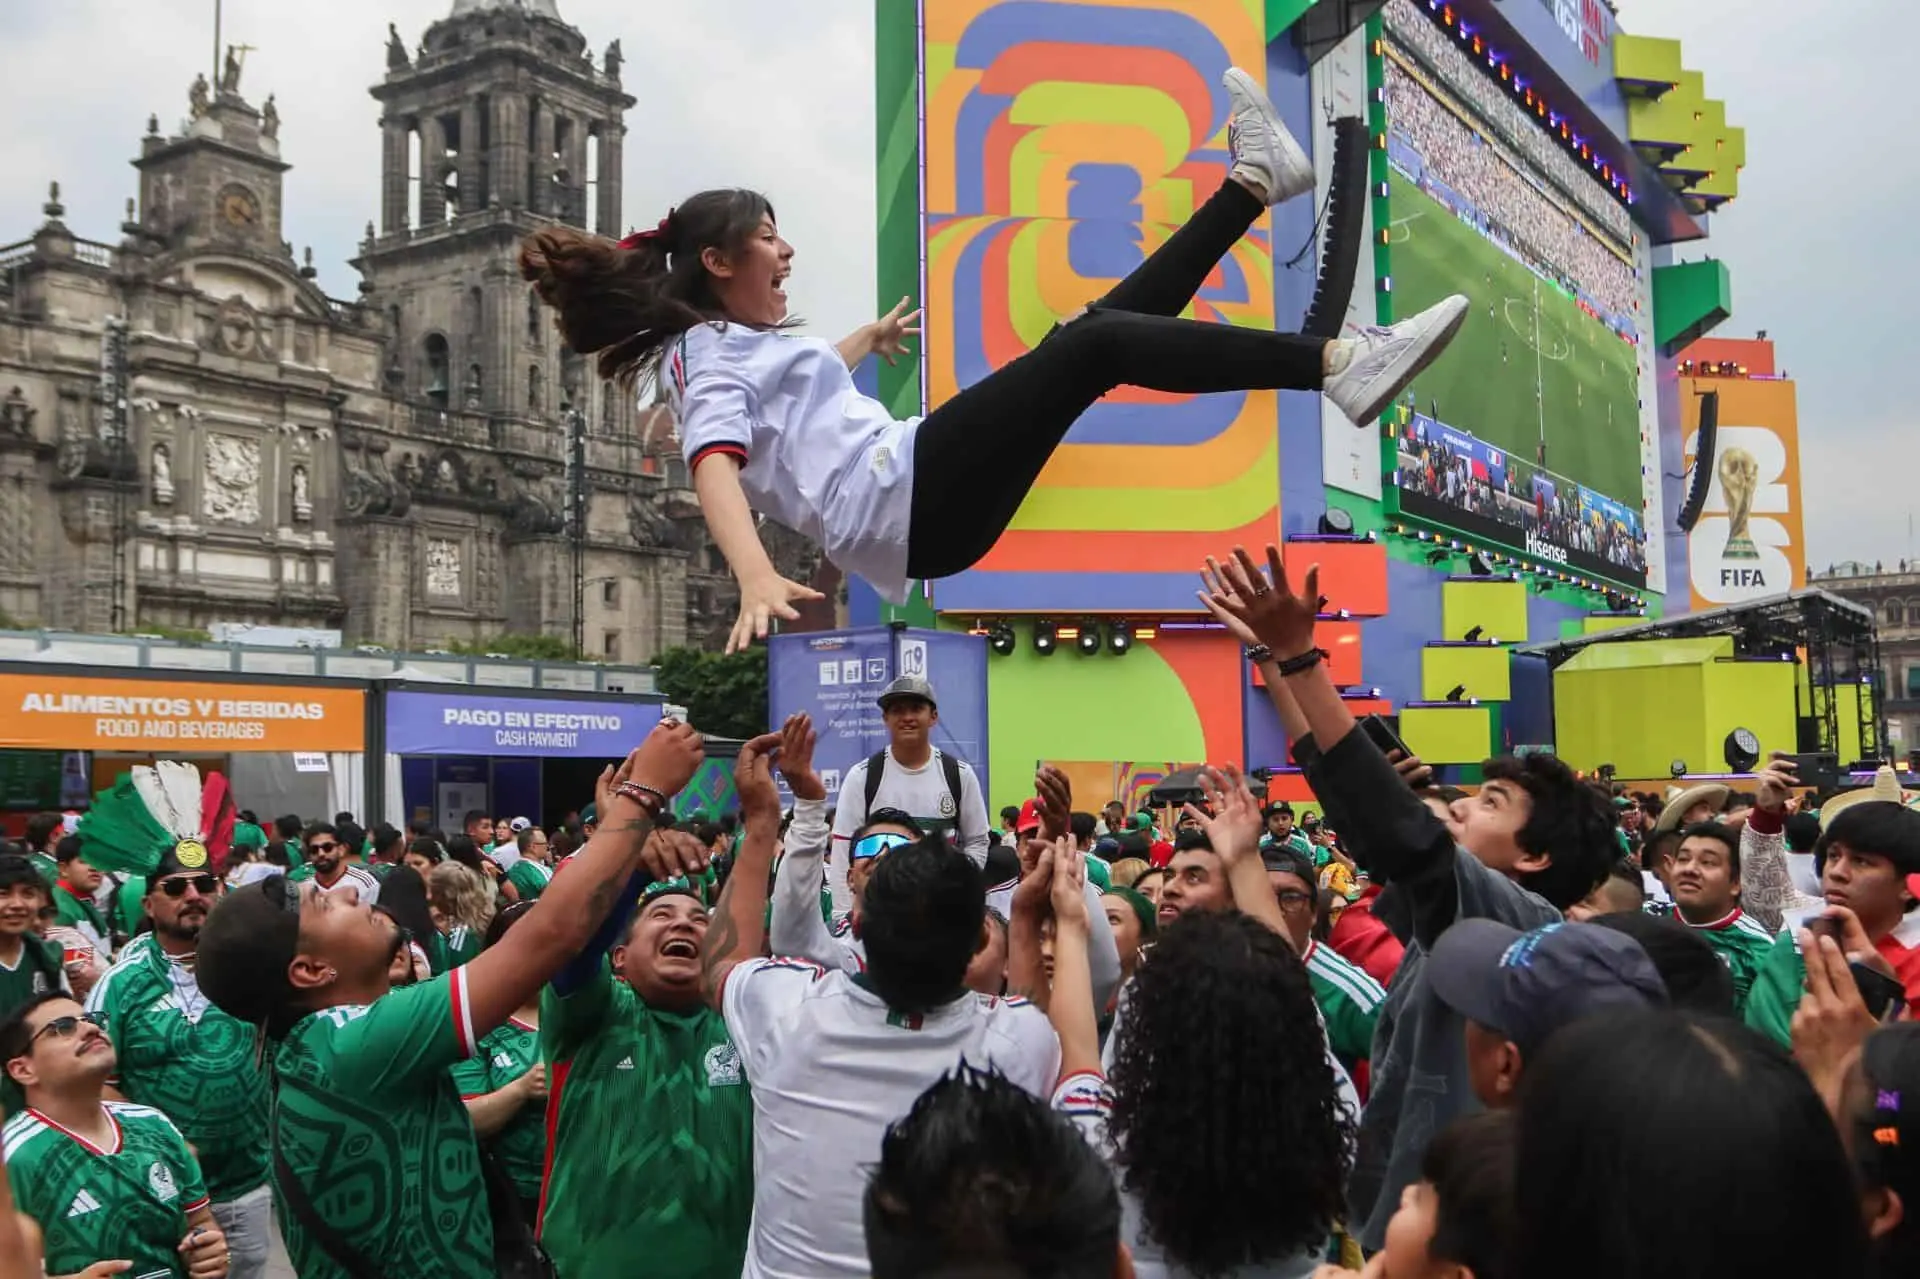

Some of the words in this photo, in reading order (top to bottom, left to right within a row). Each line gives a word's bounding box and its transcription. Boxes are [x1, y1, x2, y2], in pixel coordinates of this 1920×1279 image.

[1526, 530, 1567, 565] Hisense
[1720, 568, 1766, 587] FIFA
[21, 693, 190, 716] ALIMENTOS
[218, 700, 324, 719] BEBIDAS
[96, 718, 140, 737] FOOD
[143, 720, 176, 738] AND
[178, 721, 265, 739] BEVERAGES
[444, 708, 501, 726] PAGO
[504, 711, 530, 727] EN
[533, 713, 621, 730] EFECTIVO
[496, 730, 527, 746] CASH
[528, 731, 577, 748] PAYMENT
